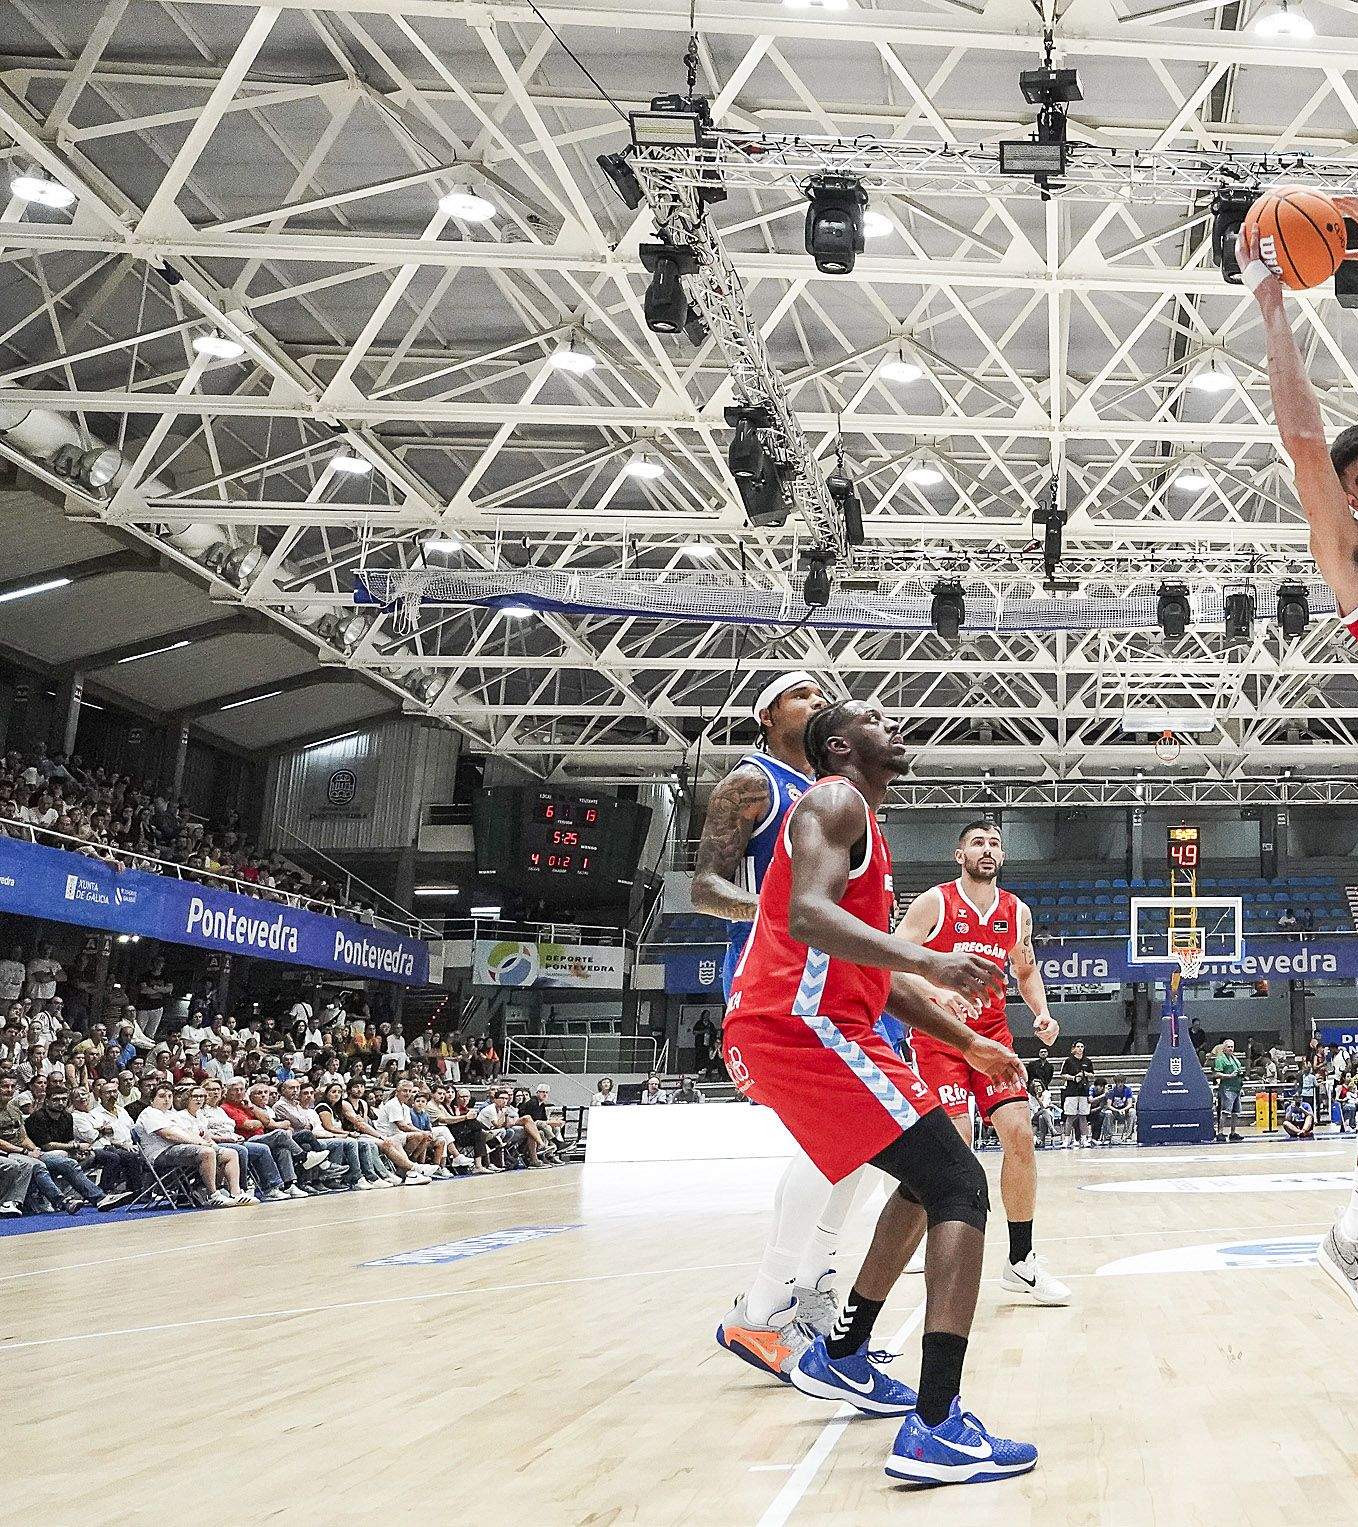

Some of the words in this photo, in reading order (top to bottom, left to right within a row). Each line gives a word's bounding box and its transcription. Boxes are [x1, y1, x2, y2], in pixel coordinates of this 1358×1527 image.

[553, 831, 577, 845] 5:25
[79, 880, 99, 891] XUNTA
[76, 890, 85, 900] DE
[87, 892, 109, 904] GALICIA
[187, 897, 298, 953] Pontevedra
[333, 930, 414, 976] Pontevedra
[545, 955, 594, 963] DEPORTE
[545, 964, 615, 972] PONTEVEDRA
